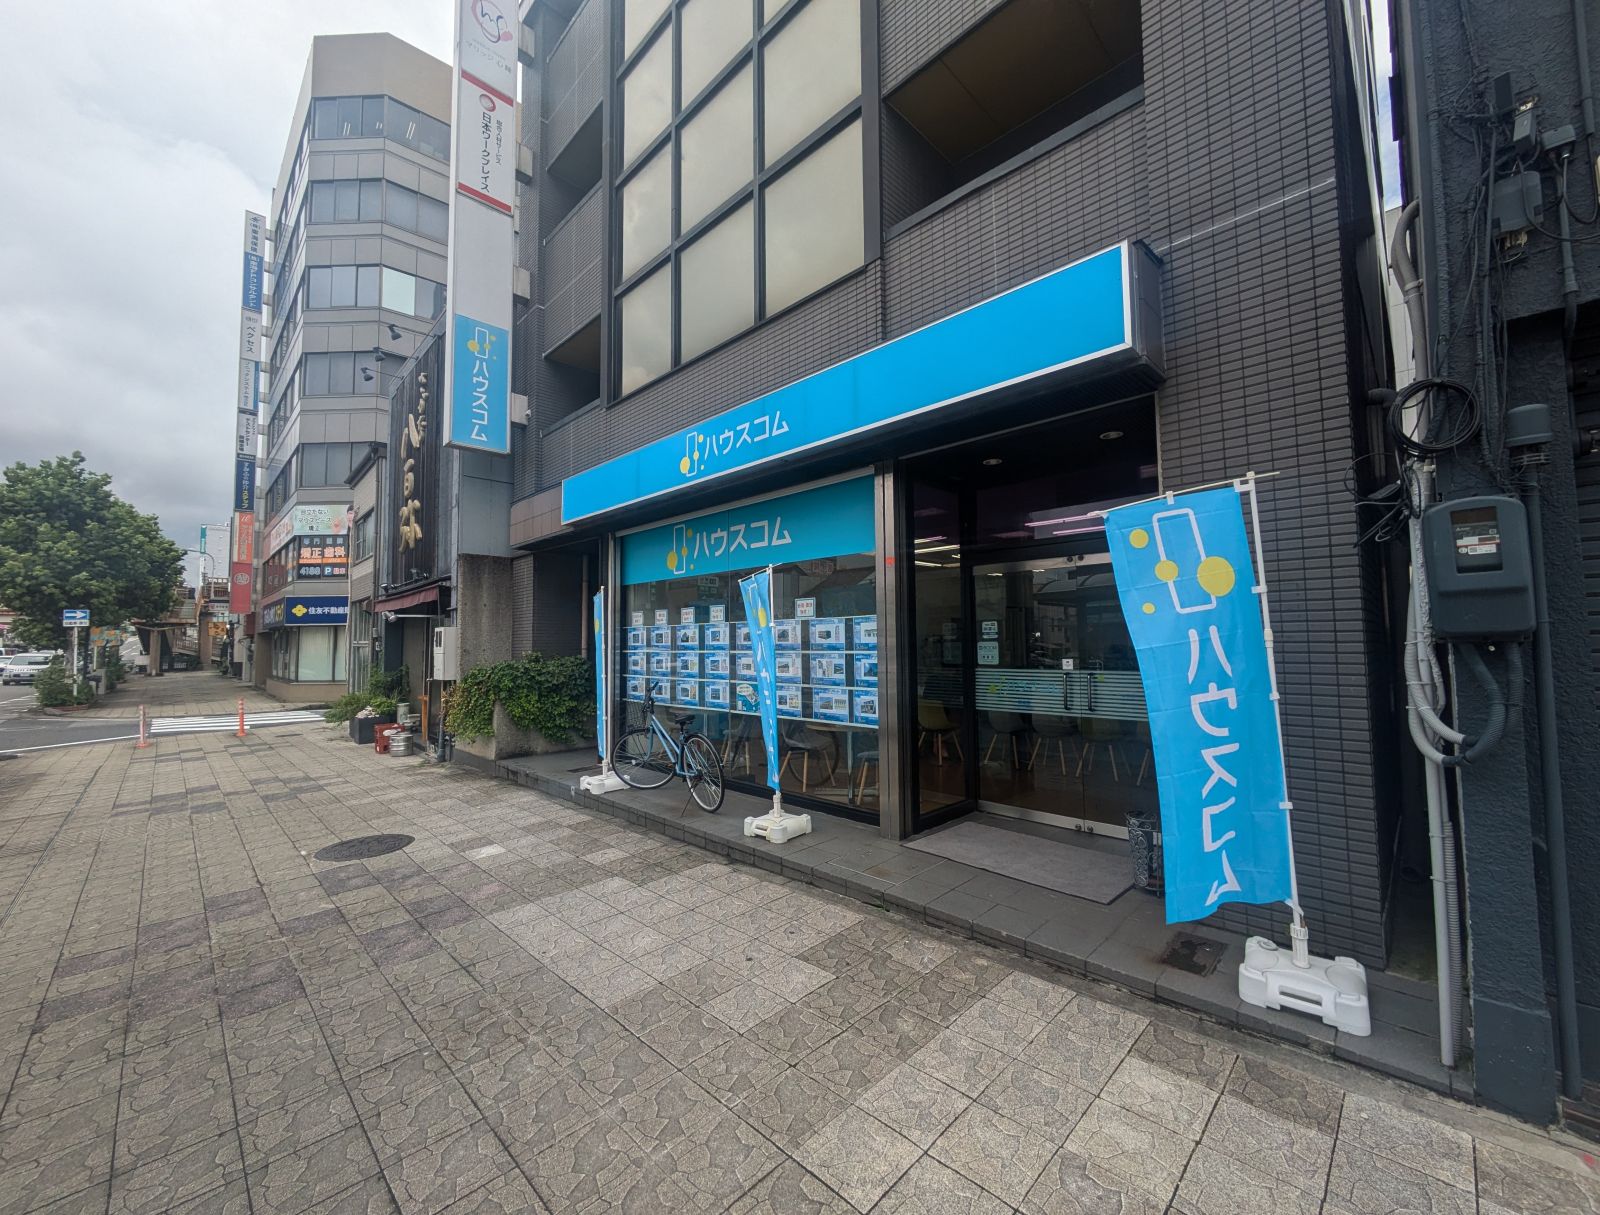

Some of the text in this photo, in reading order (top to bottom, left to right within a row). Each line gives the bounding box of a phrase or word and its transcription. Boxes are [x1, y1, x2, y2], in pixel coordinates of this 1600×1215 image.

[470, 360, 489, 441] ハウスコム
[704, 410, 790, 460] ハウスコム
[694, 516, 792, 560] ハウスコム
